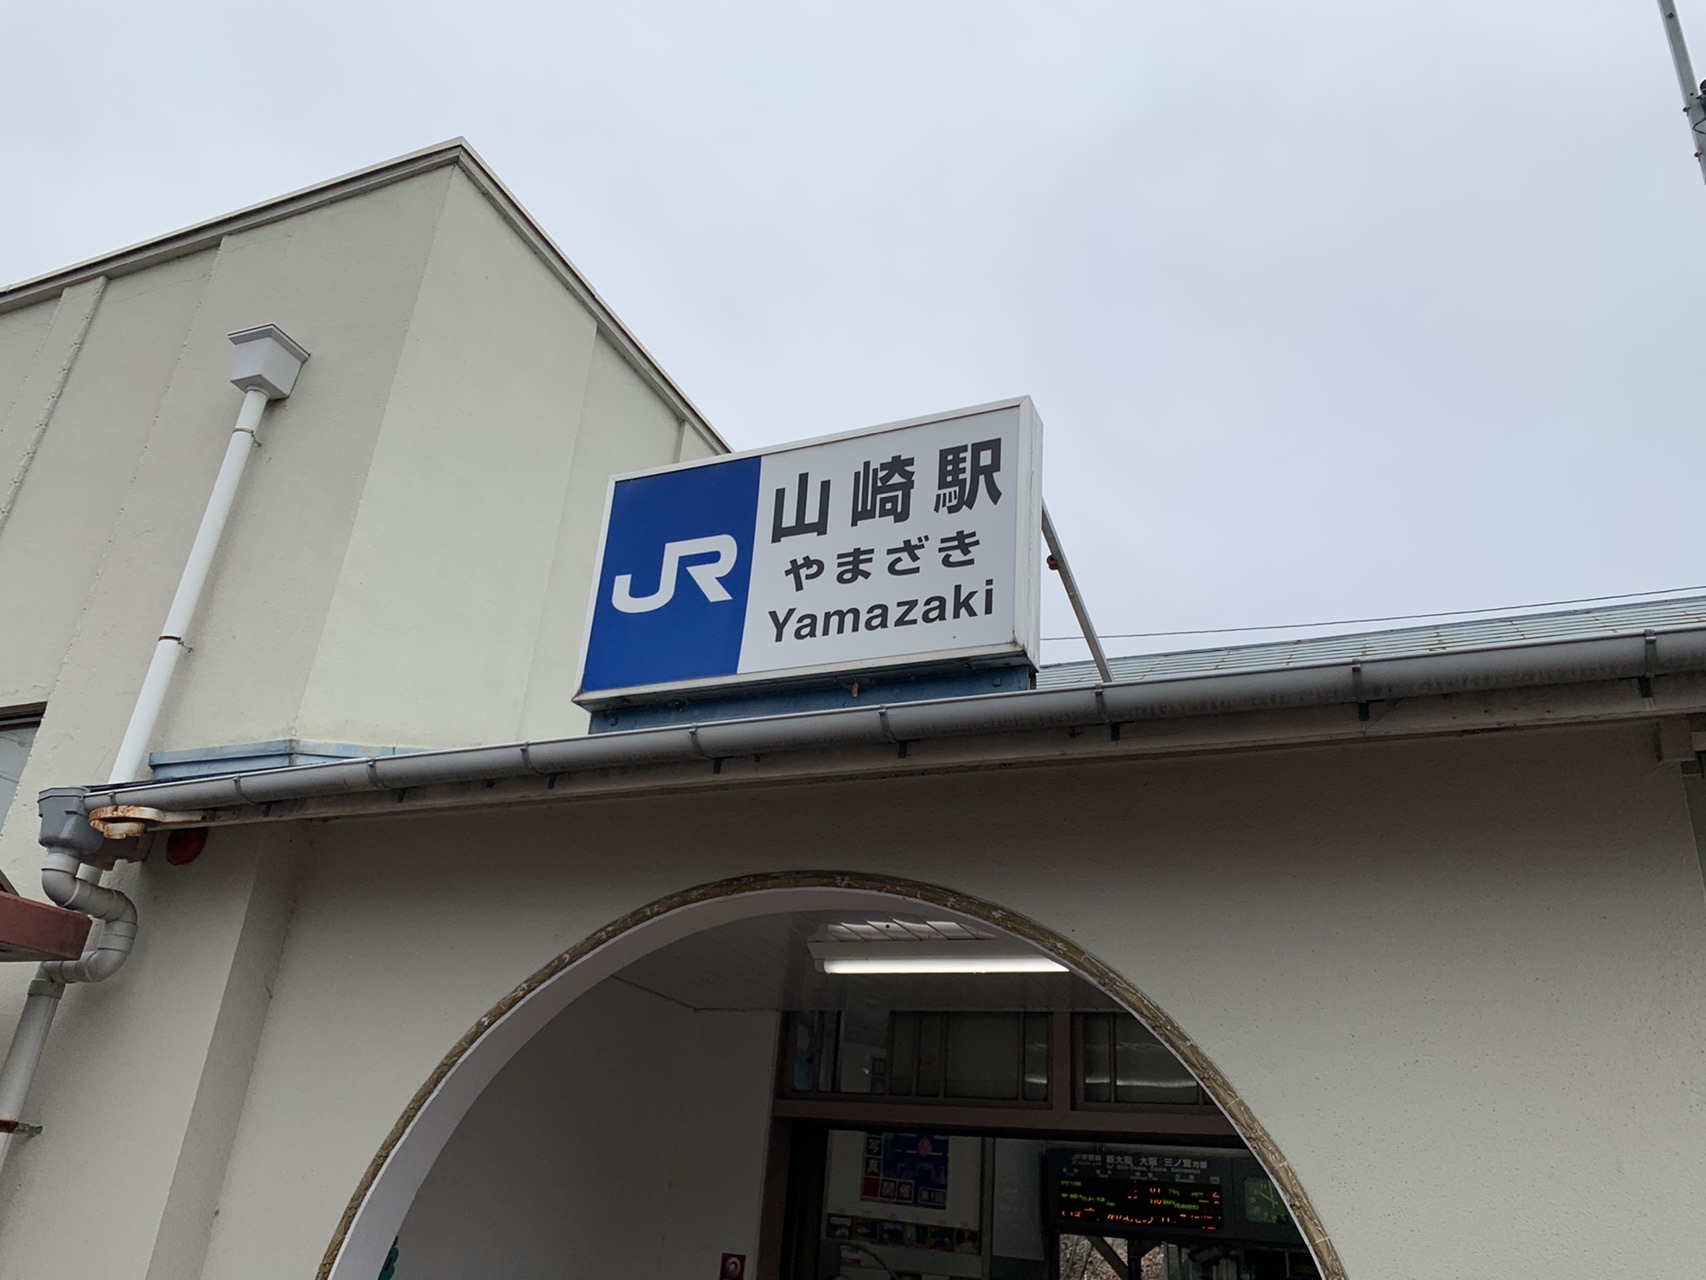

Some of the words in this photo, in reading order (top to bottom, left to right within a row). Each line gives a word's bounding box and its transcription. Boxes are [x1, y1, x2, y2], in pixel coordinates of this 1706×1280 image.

[771, 437, 1003, 544] 山崎駅
[611, 534, 738, 614] JR
[784, 530, 981, 592] やまざき
[768, 578, 994, 643] Yamazaki
